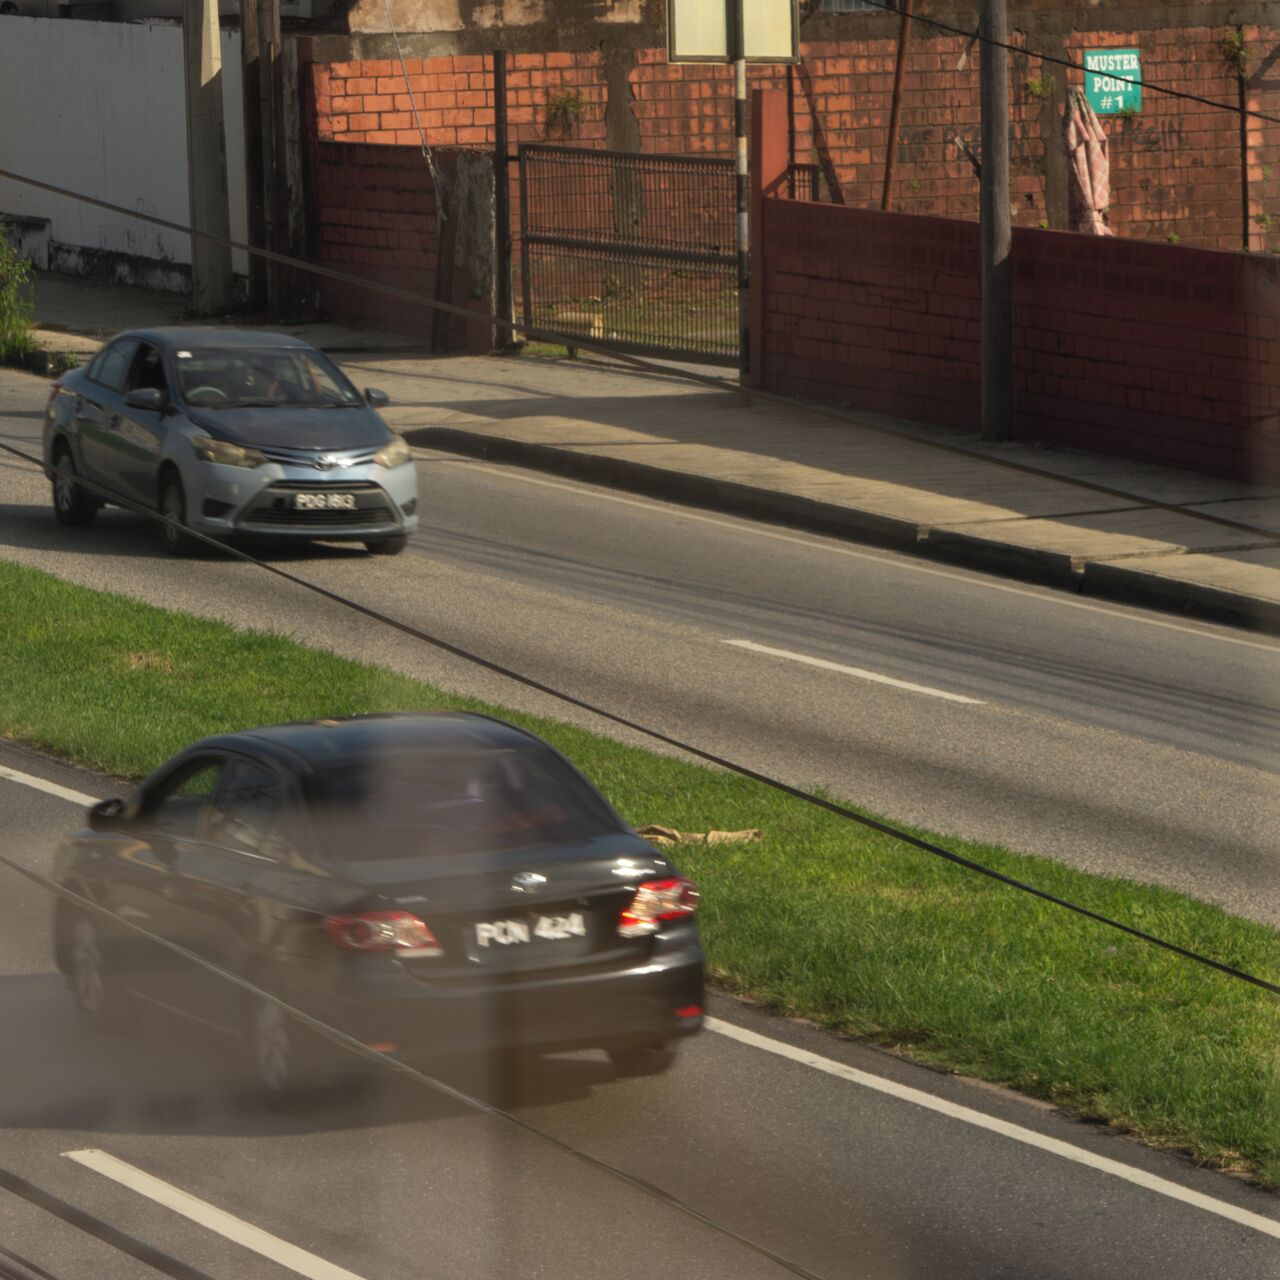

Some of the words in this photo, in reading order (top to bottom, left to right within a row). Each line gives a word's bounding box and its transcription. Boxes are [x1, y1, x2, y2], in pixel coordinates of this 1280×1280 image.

[1086, 53, 1139, 72] MUSTER
[1093, 75, 1134, 93] POINT
[1100, 95, 1124, 110] #1
